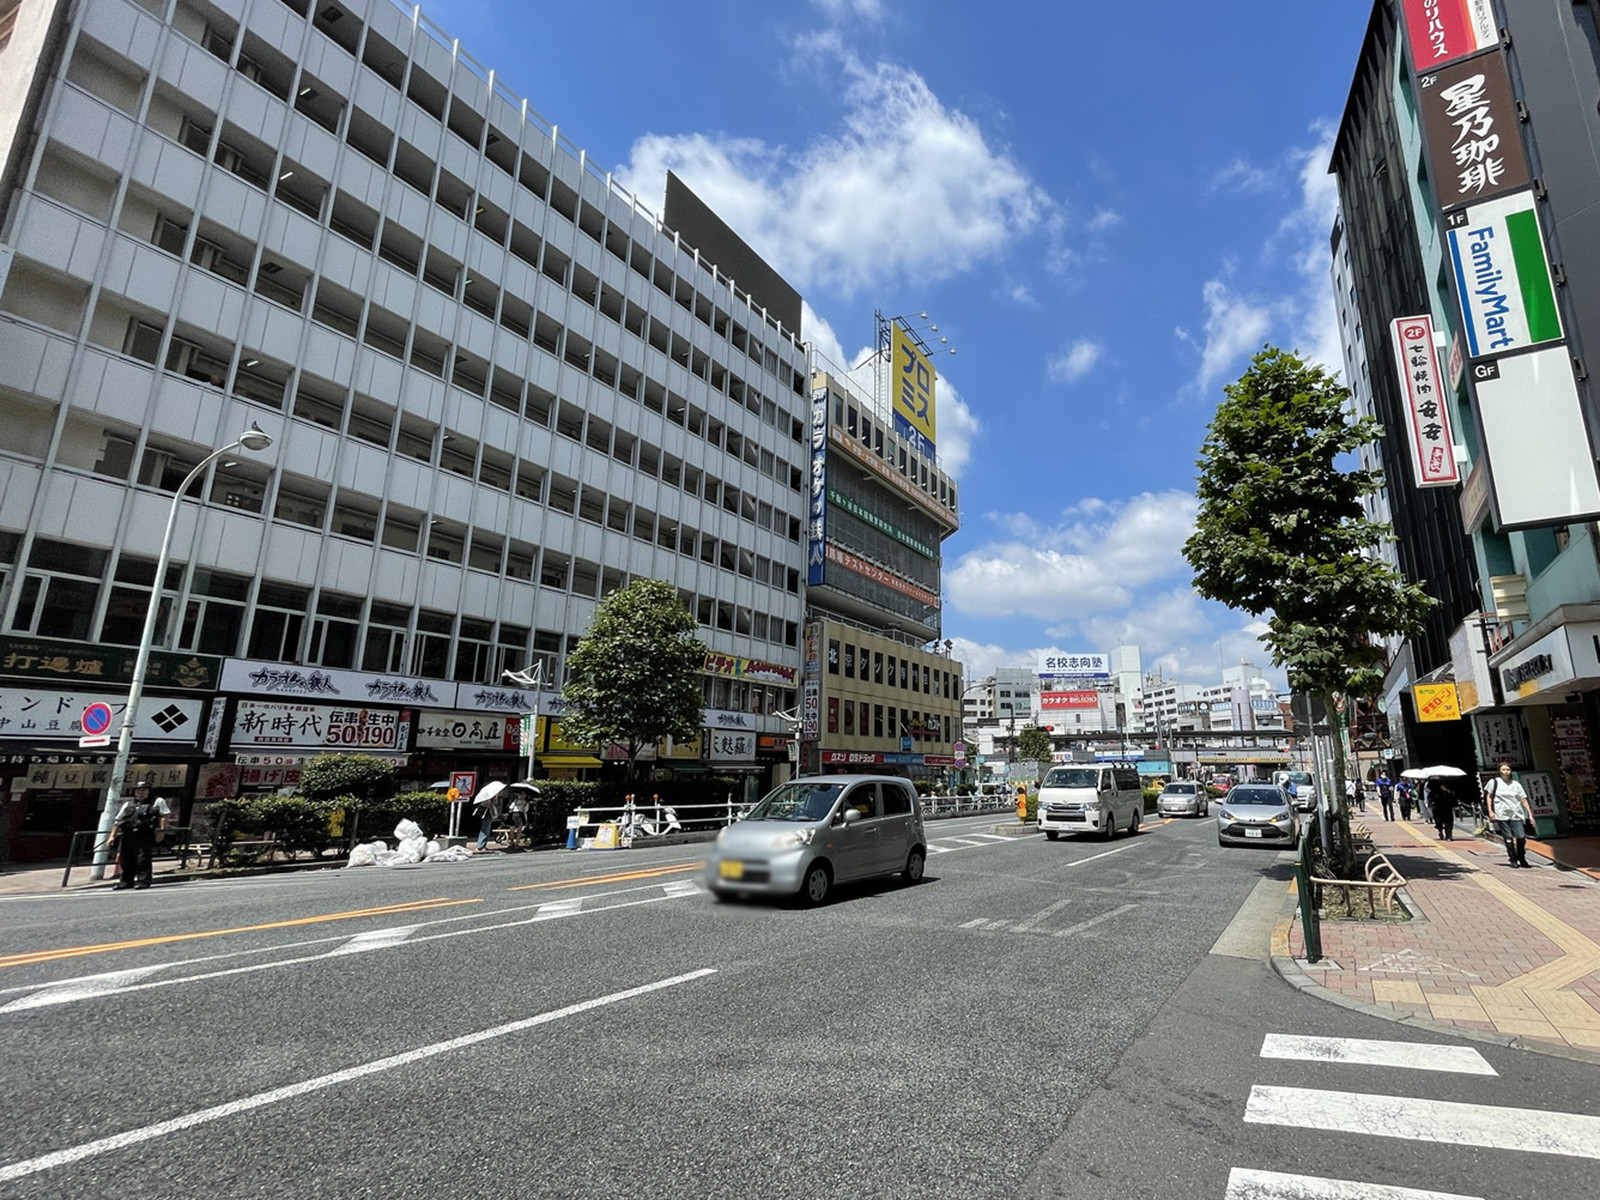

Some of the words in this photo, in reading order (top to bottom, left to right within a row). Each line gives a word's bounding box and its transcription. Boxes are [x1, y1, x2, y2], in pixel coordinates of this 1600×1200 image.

[1421, 76, 1437, 88] 2F
[1440, 74, 1505, 193] 星乃珈琲
[1447, 215, 1465, 226] 1F
[1468, 226, 1514, 349] FamilyMart
[1407, 328, 1422, 338] 2F
[1475, 365, 1496, 378] GF
[809, 407, 826, 567] カラオケの鉄人
[1045, 656, 1103, 668] 名校志向塾
[249, 667, 340, 694] カラオケの鉄人
[366, 678, 438, 702] カラオケの鉄人
[805, 698, 818, 710] 50
[239, 711, 322, 736] 新時代
[330, 710, 358, 725] 伝串
[368, 713, 395, 726] 生中
[326, 724, 356, 744] 50
[362, 726, 394, 744] 190
[452, 721, 501, 740] 日高屋
[804, 721, 818, 732] 190
[0, 755, 139, 766] 持ち帰りできす
